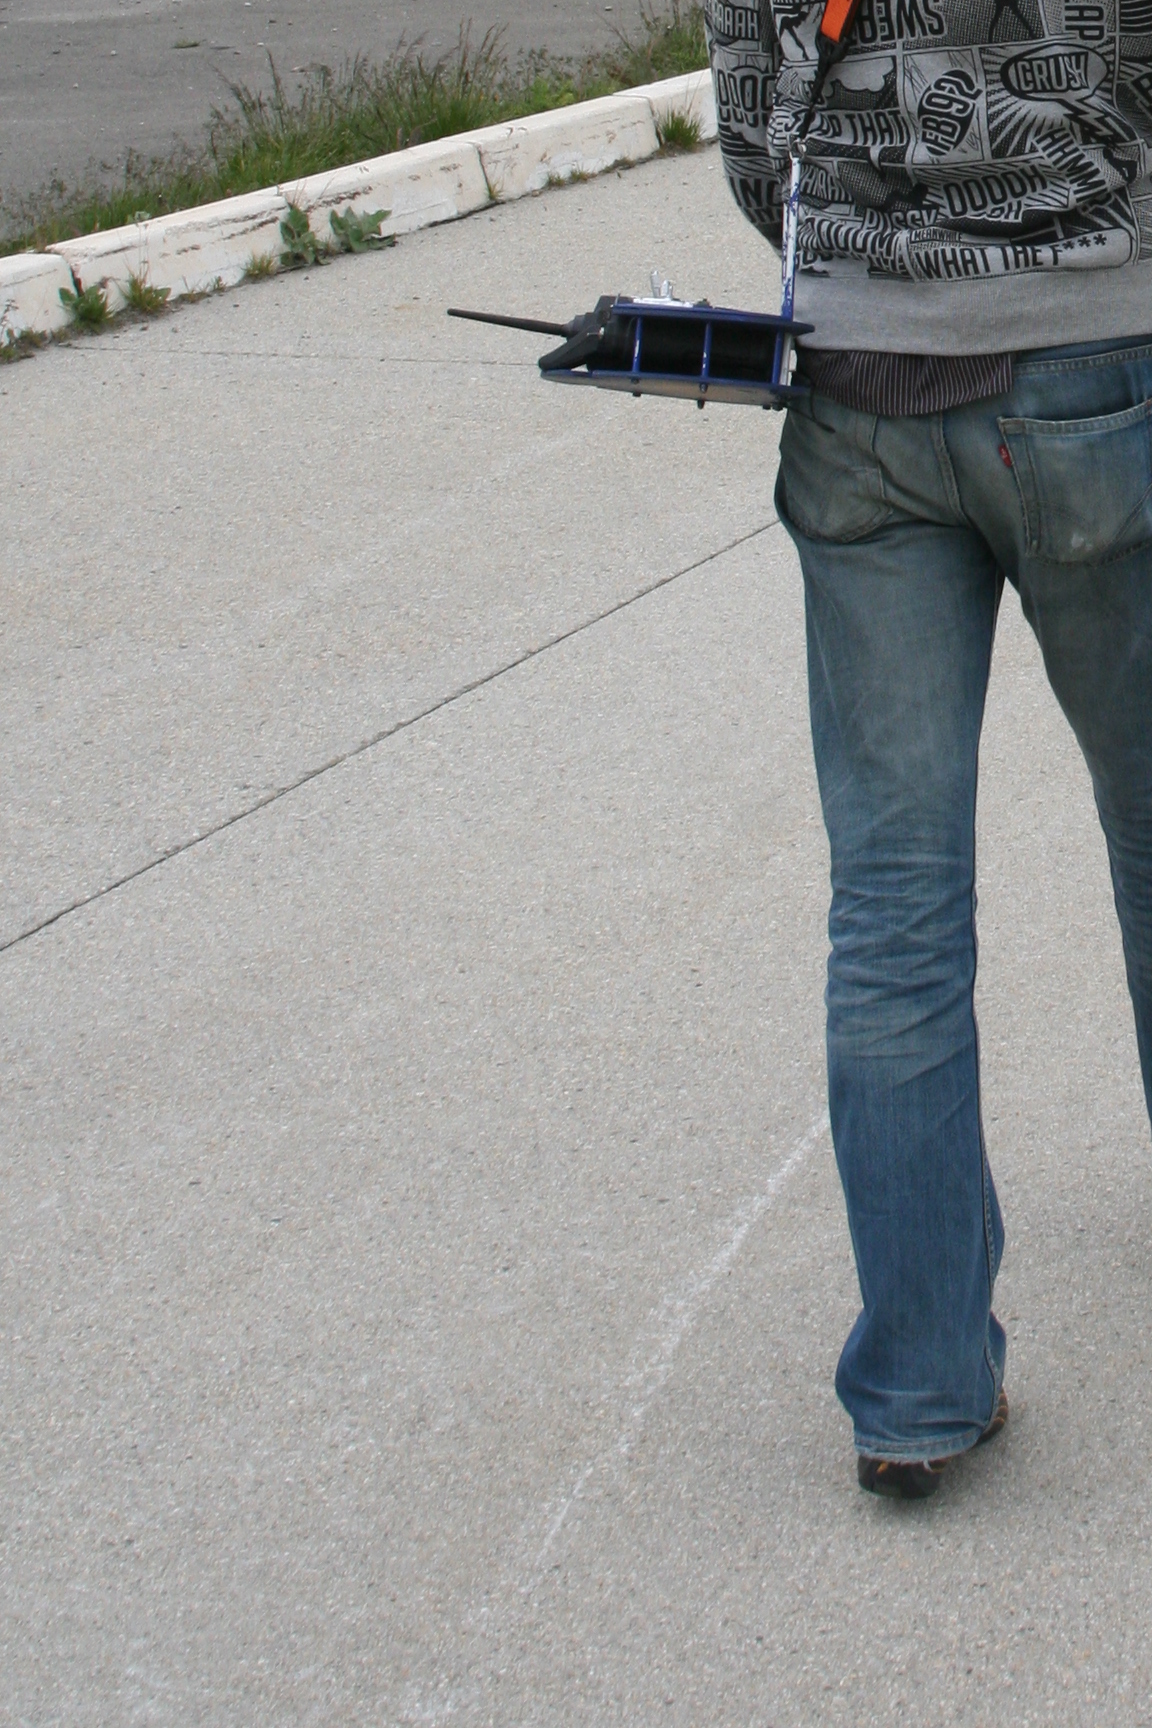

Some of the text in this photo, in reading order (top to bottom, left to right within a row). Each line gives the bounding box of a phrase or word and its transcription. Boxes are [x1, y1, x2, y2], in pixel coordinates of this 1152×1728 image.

[944, 165, 1048, 217] OOOOH
[914, 247, 992, 280] WHAT
[999, 244, 1045, 271] THE
